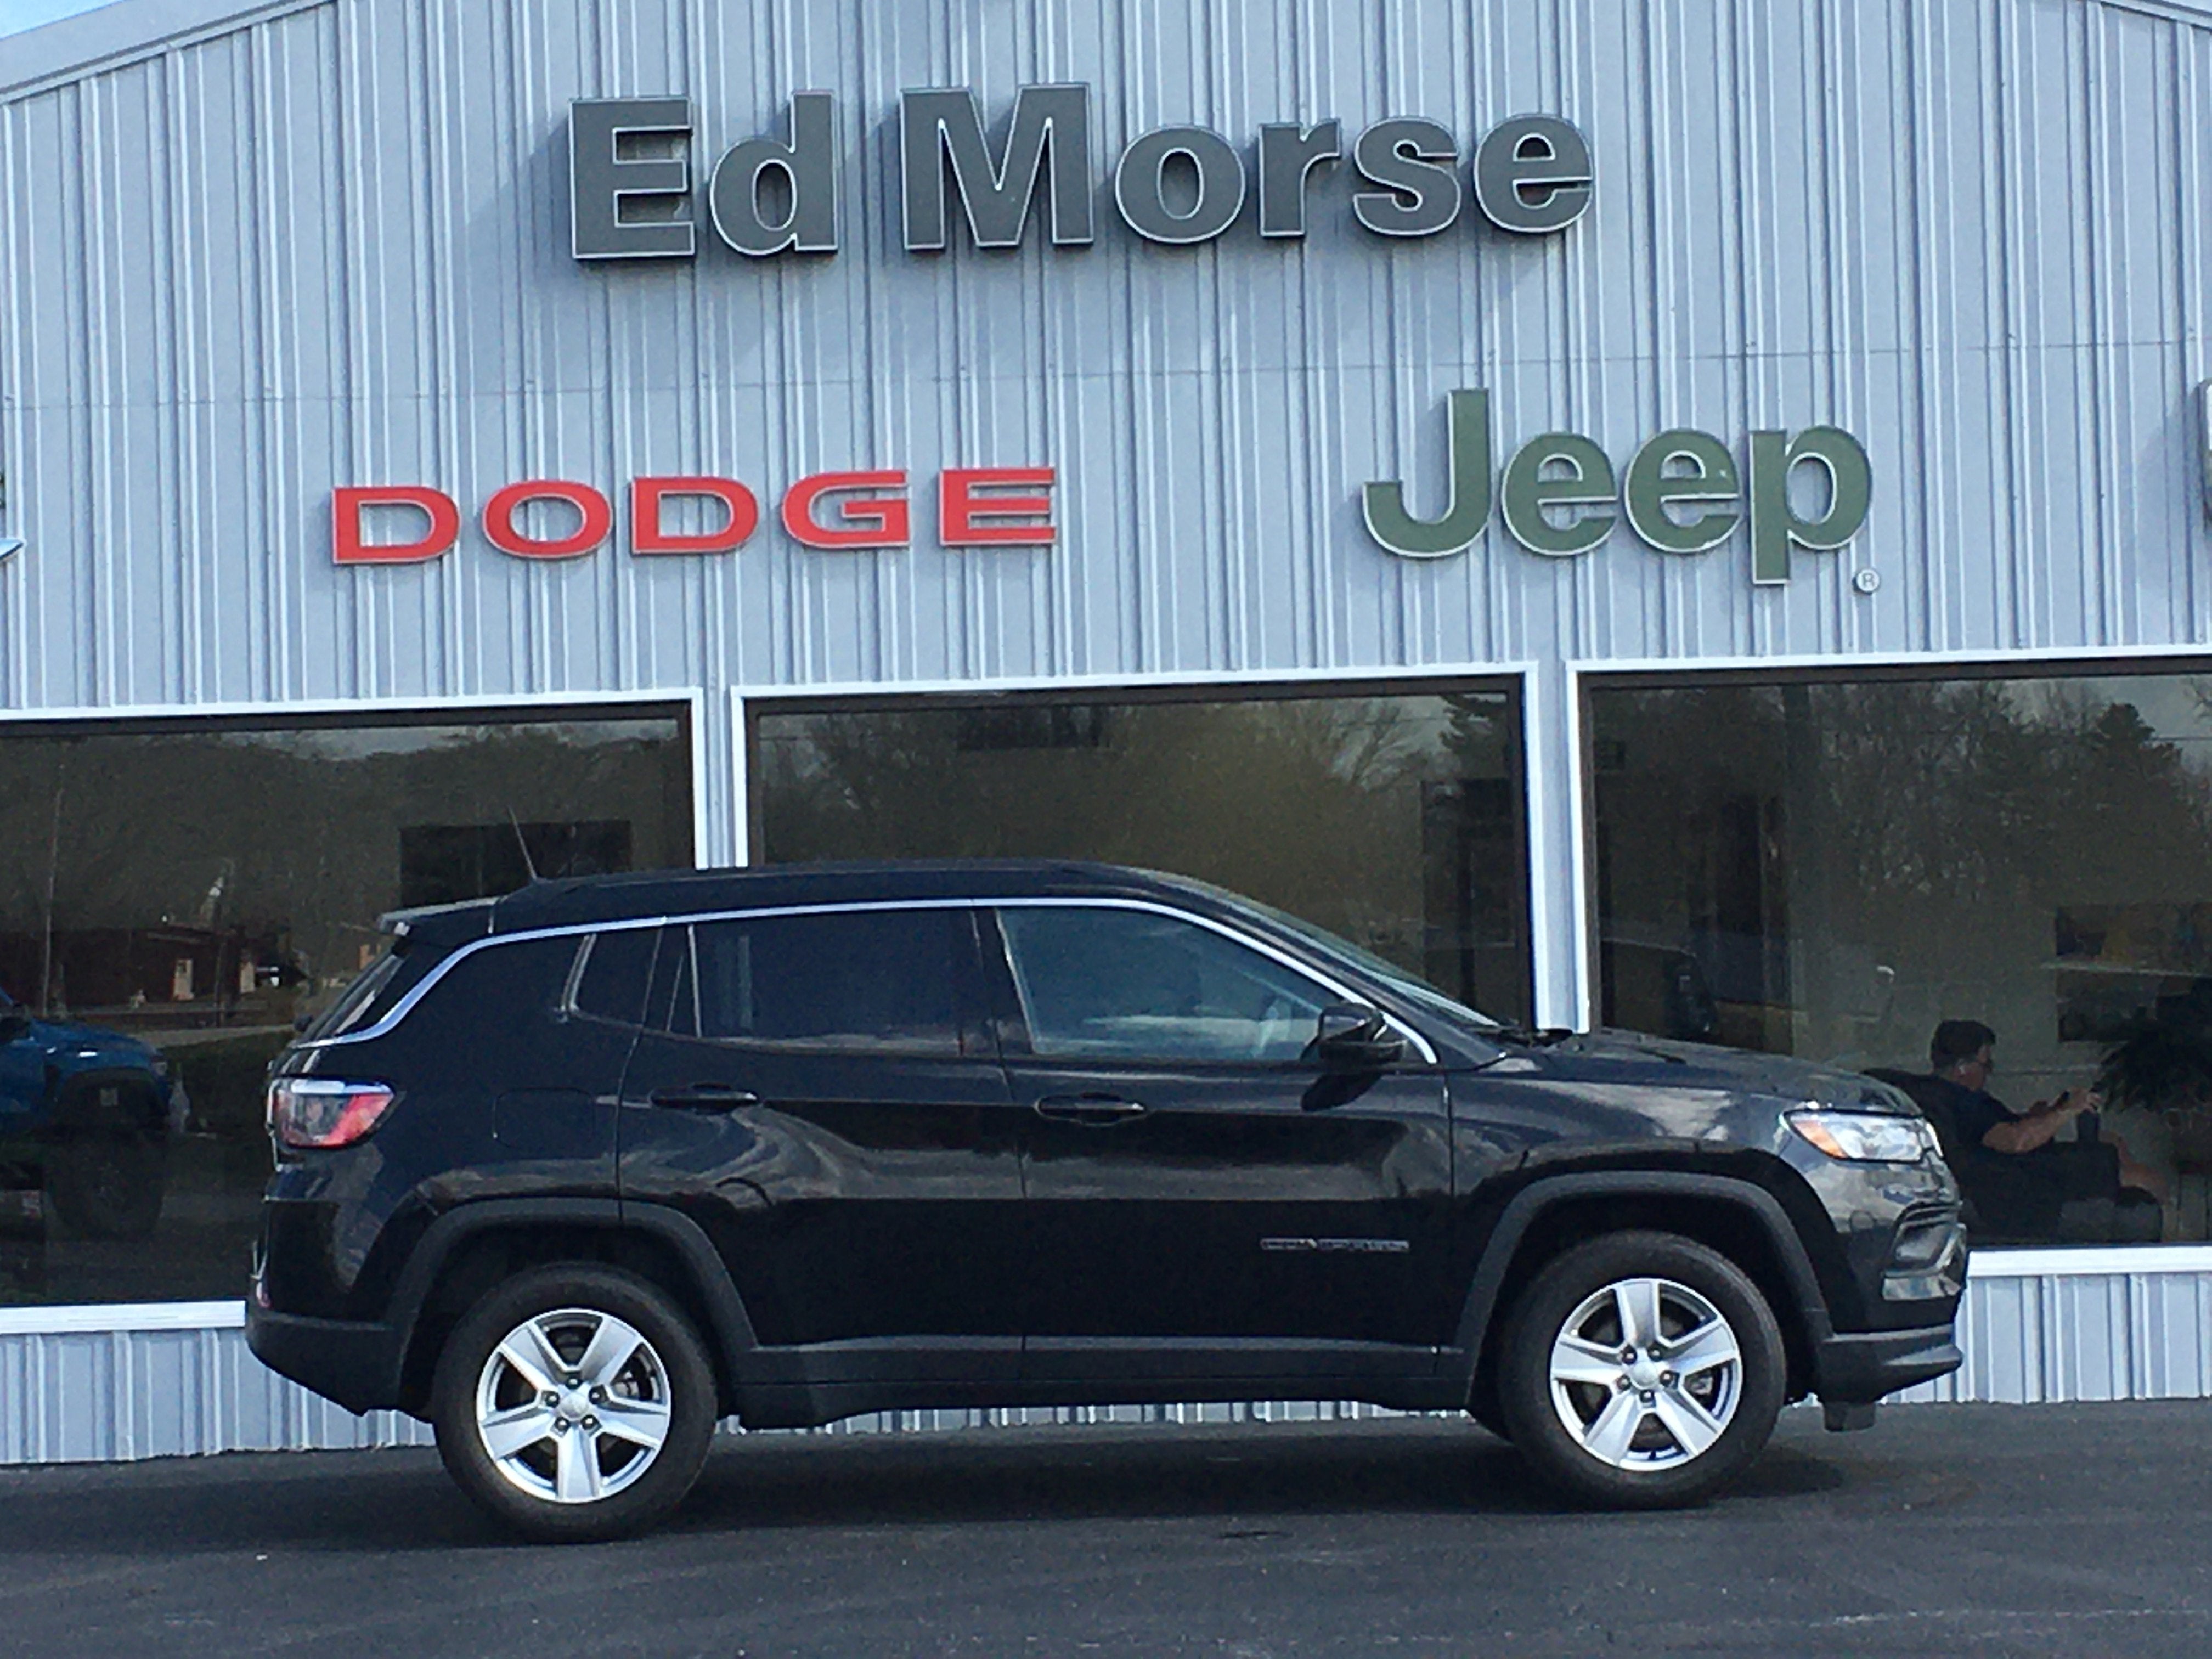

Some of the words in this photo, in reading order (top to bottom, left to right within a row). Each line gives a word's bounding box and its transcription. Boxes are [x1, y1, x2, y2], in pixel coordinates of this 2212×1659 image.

[569, 89, 839, 260] Ed
[900, 82, 1594, 250] Morse
[331, 467, 1057, 565] DODGE
[1362, 388, 1872, 585] Jeep
